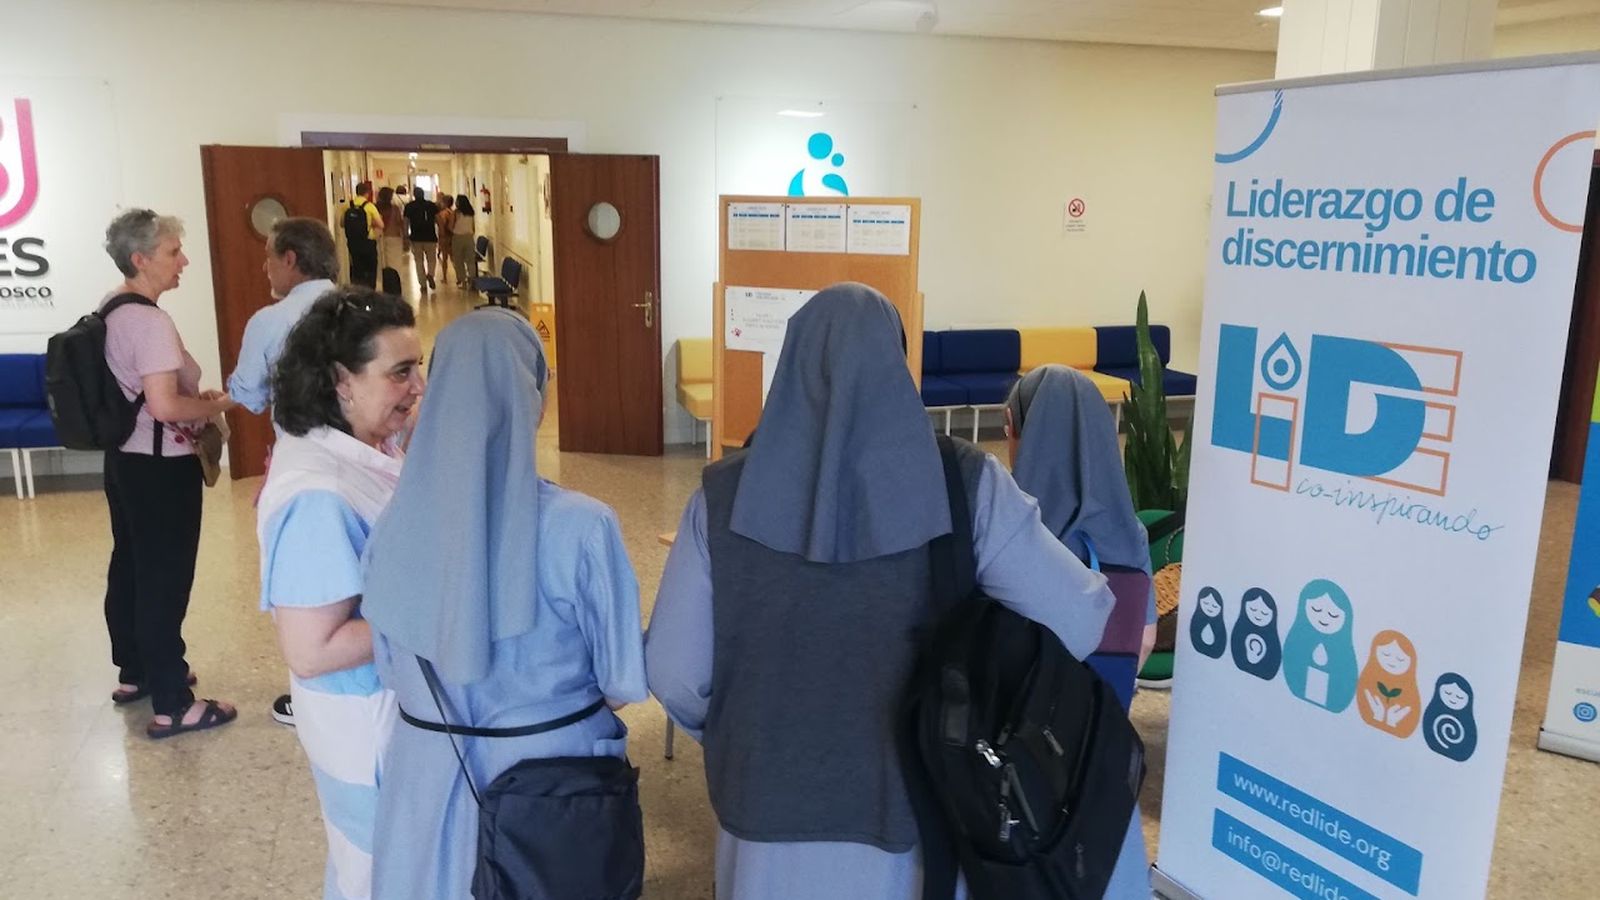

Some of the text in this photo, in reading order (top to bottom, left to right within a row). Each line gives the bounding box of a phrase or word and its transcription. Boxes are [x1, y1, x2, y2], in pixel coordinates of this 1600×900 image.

[1226, 176, 1496, 232] Liderazgo de
[1221, 228, 1538, 284] discernimiento
[1296, 478, 1505, 540] co-inspirando
[1233, 773, 1392, 871] www.redlide.org
